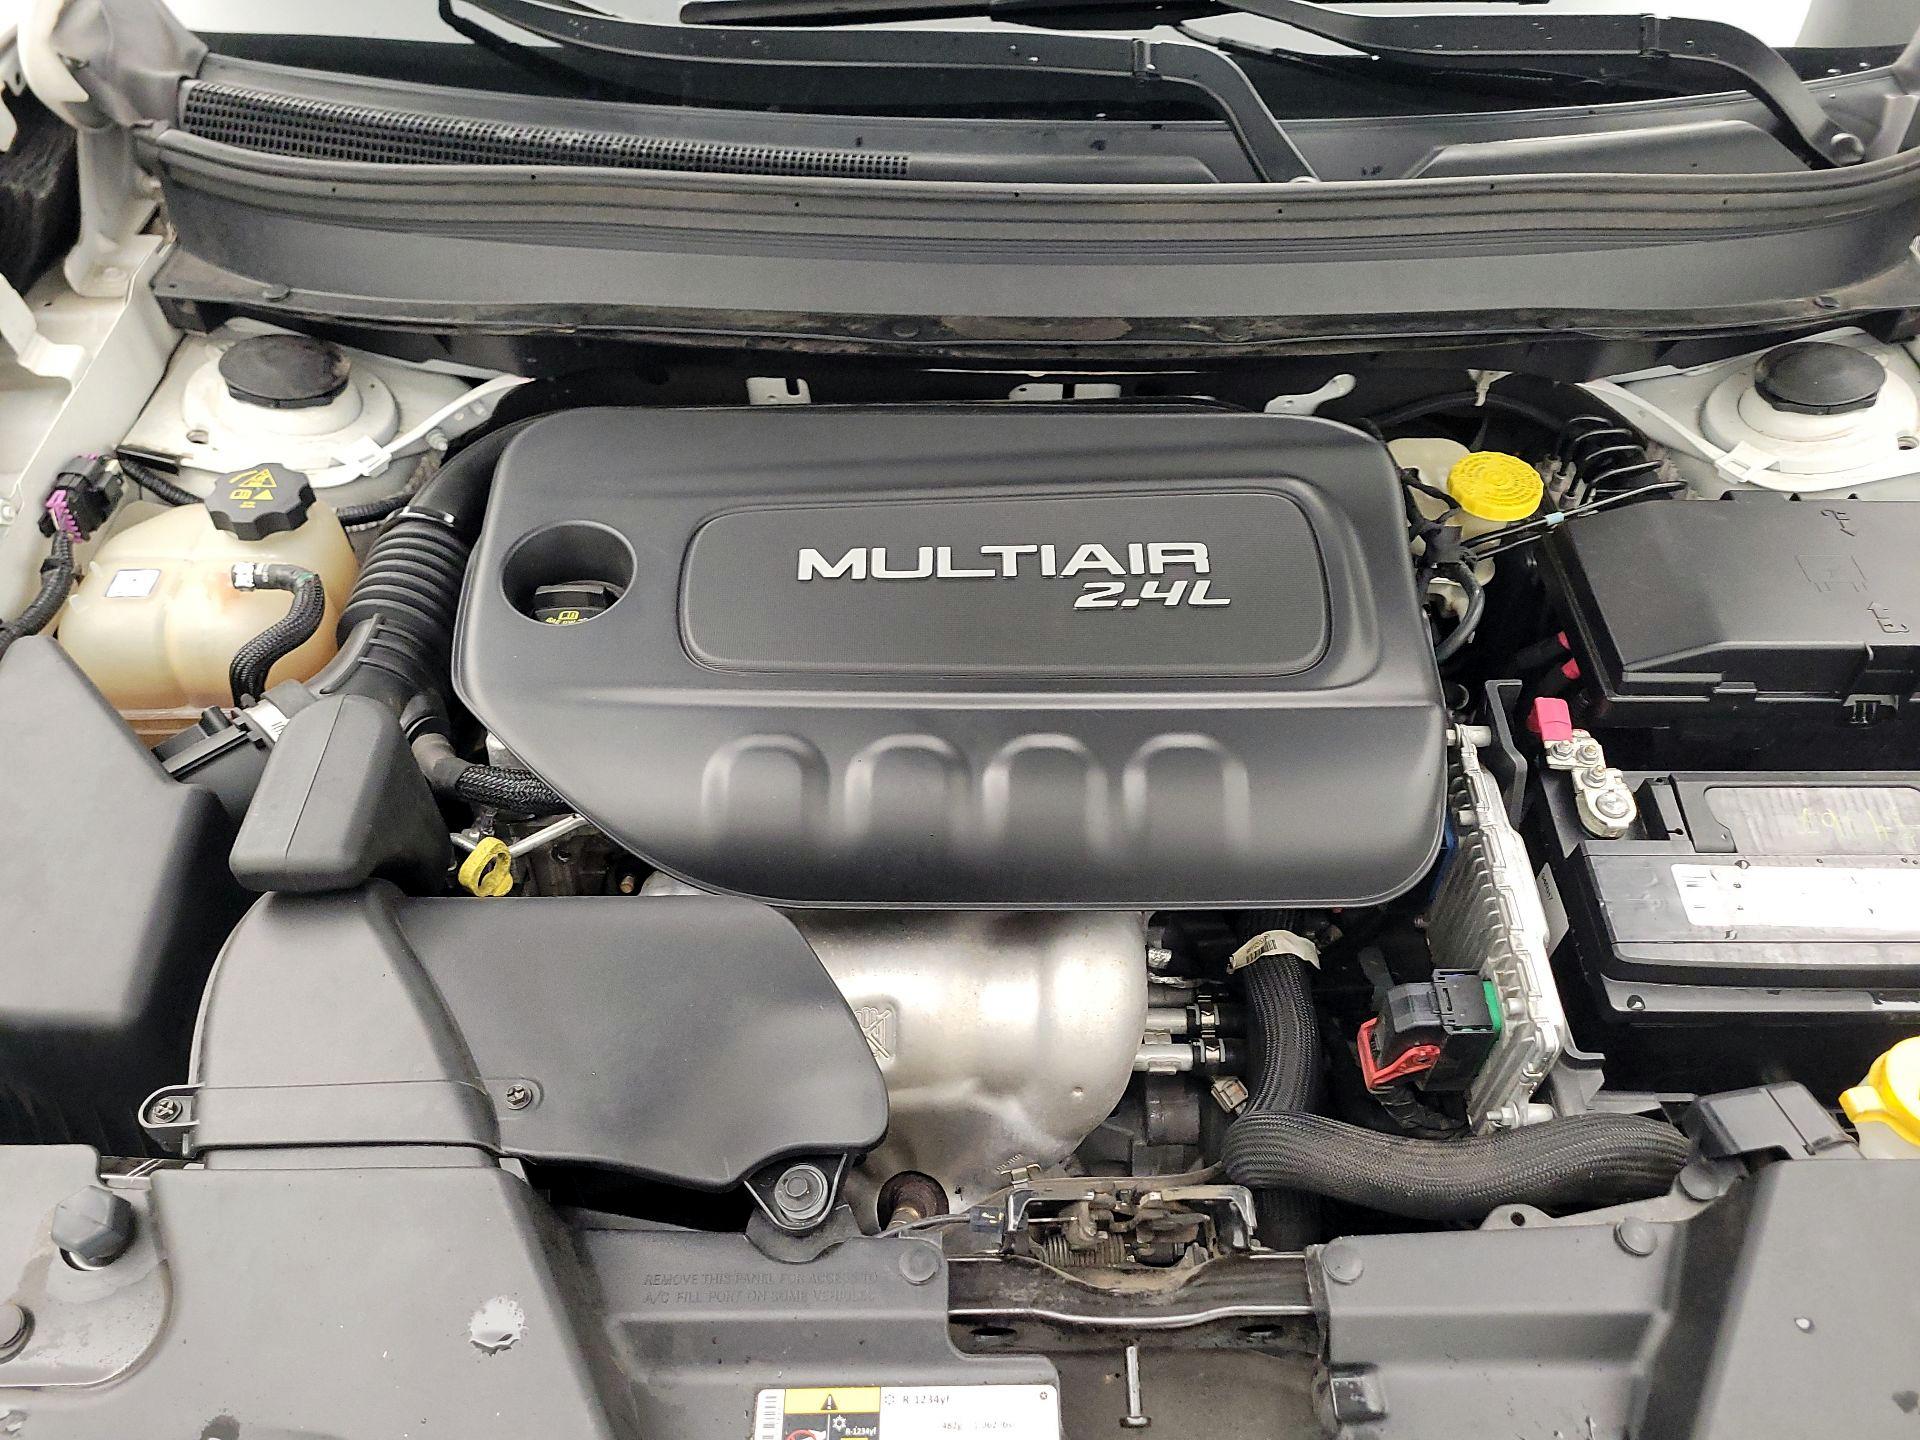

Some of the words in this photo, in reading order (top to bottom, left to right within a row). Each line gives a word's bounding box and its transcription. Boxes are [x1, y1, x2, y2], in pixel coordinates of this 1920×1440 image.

[797, 541, 1211, 581] MULTIAIR
[1073, 579, 1231, 609] 2.4L
[643, 1272, 699, 1286] REMOVE
[702, 1272, 731, 1285] THIS
[733, 1272, 775, 1285] PANEL
[643, 1290, 670, 1304] A/C
[675, 1290, 702, 1303] FILL
[707, 1290, 742, 1303] PORT
[845, 1426, 877, 1437] R-1234yf
